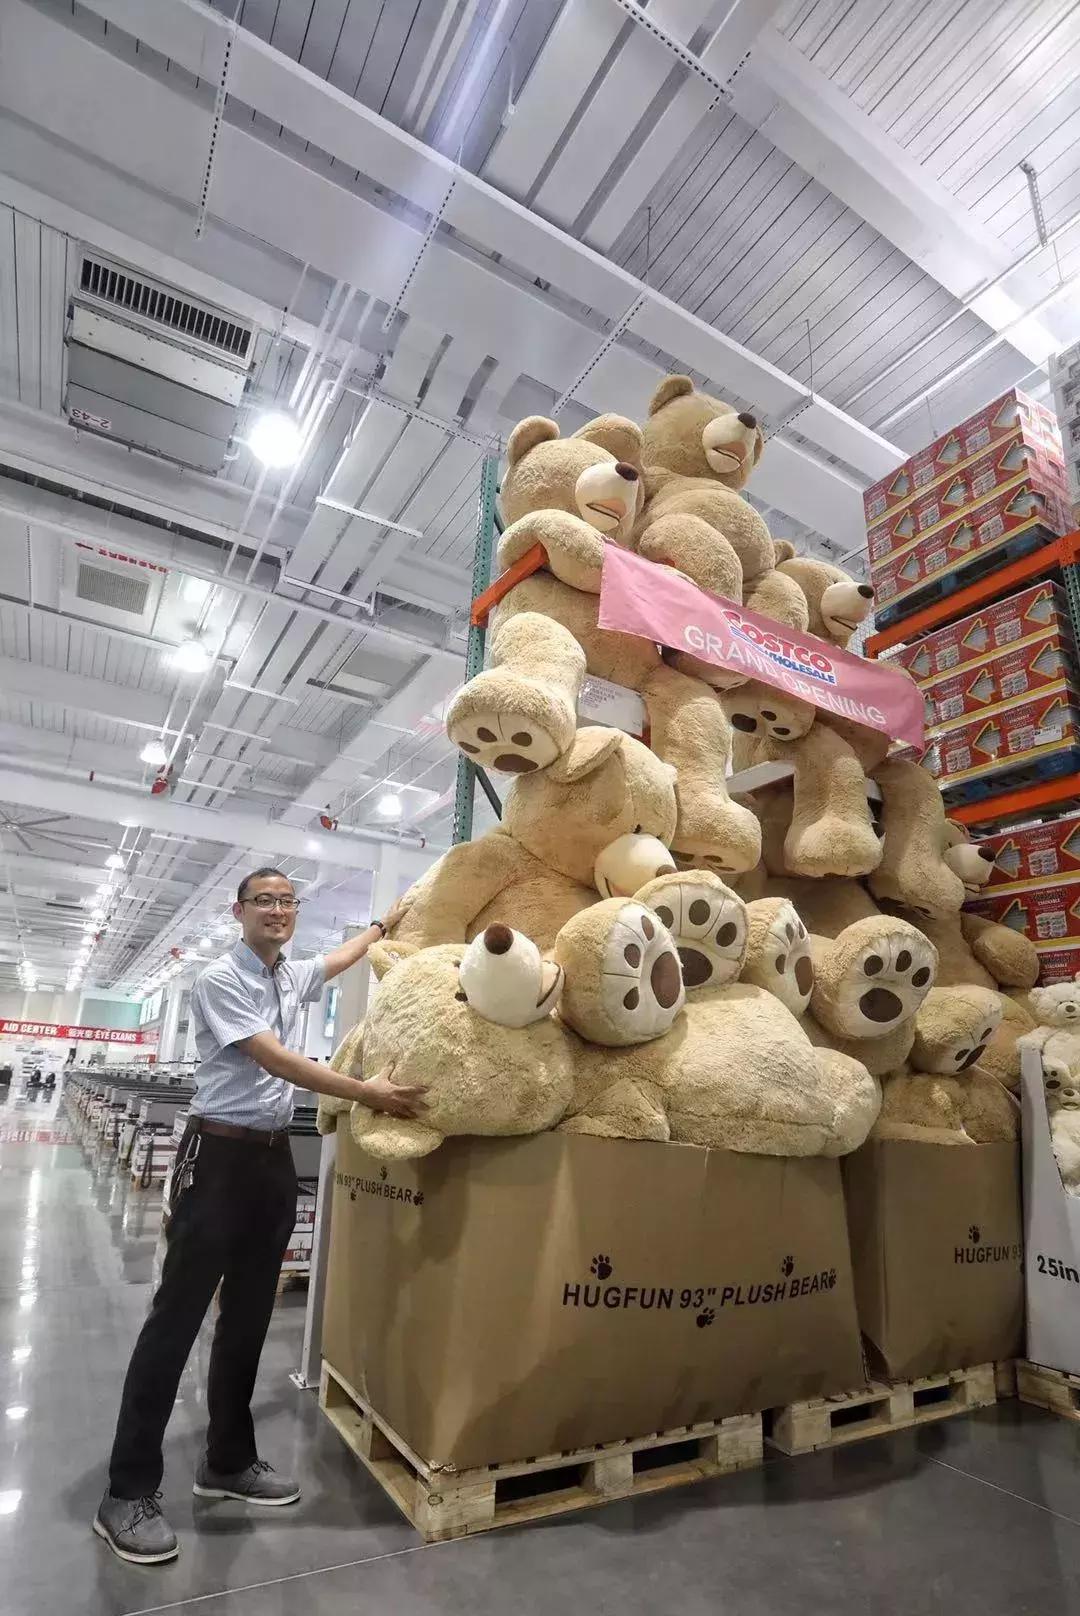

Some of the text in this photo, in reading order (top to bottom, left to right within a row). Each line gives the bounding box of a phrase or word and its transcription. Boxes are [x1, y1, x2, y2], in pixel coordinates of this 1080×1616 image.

[72, 408, 109, 428] 2-43
[721, 609, 835, 673] COSTCO
[684, 625, 887, 725] GRAND OPENING
[767, 650, 837, 685] WHOLESALE
[2, 1023, 18, 1033] AID
[20, 1025, 58, 1036] CENTER
[95, 1030, 110, 1040] EYE
[110, 1032, 137, 1042] EXAMS
[356, 1178, 382, 1196] PLUSH
[384, 1185, 412, 1203] BEAR
[954, 1245, 1009, 1263] HUGFUN
[1037, 1252, 1080, 1284] 25in
[562, 1270, 830, 1309] HUGFUN 93" PLUSH BEAR
